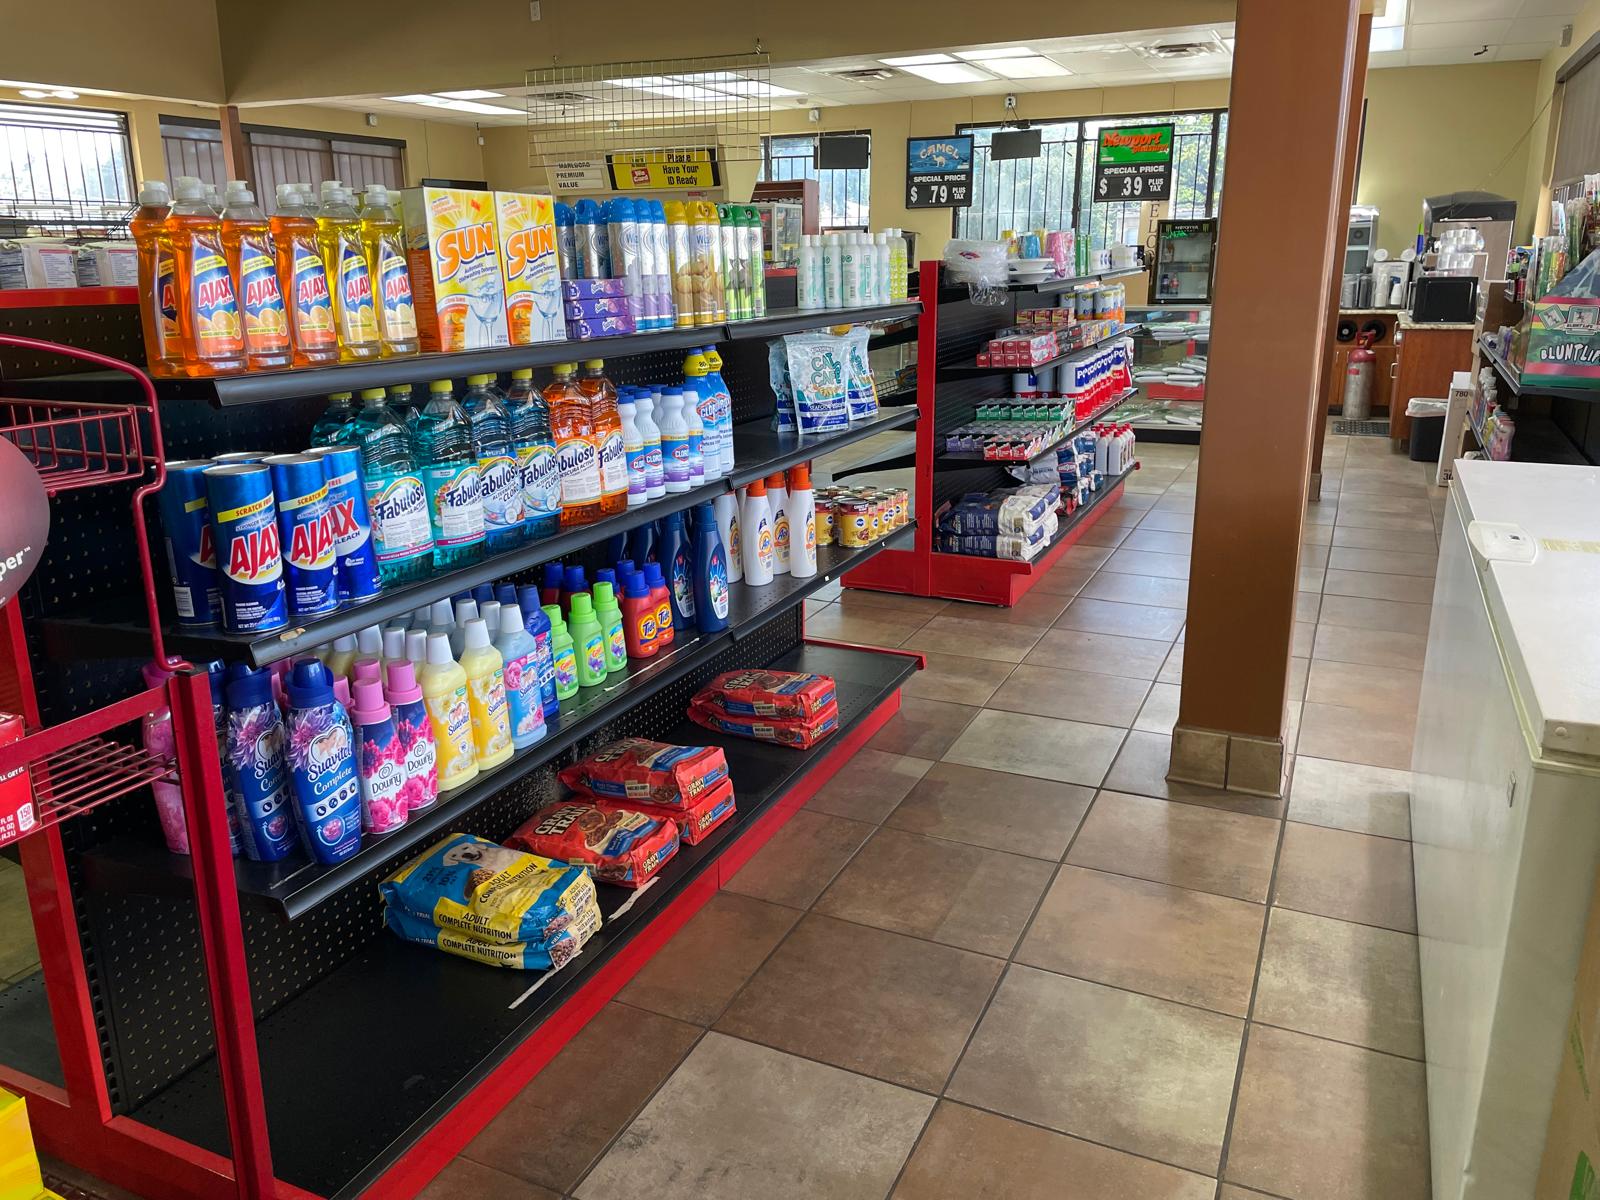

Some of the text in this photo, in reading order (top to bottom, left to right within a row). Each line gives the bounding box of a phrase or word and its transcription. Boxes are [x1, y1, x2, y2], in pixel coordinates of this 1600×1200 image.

[1102, 131, 1162, 147] Newport
[667, 154, 691, 162] Please
[920, 144, 959, 159] CAMEL
[662, 165, 699, 174] Have Your
[944, 174, 966, 182] PRICE
[1104, 165, 1164, 174] SPECIAL PRICE
[668, 176, 698, 186] ID Ready
[1099, 176, 1142, 196] $ .39
[1148, 178, 1164, 186] PLUS
[910, 185, 948, 203] $ .79
[436, 222, 498, 284] SUN
[506, 224, 556, 282] SUN
[198, 275, 231, 307] AJAX
[246, 275, 280, 307] AJAX
[298, 274, 327, 304] AJAX
[346, 274, 368, 304] AJAX
[386, 274, 410, 304] AJAX
[1455, 390, 1468, 398] 780
[297, 492, 321, 506] SCRATCH
[375, 484, 424, 523] Fabuloso
[235, 502, 263, 516] SCRATCH
[291, 510, 334, 566] AJA
[658, 610, 670, 624] Tide
[642, 622, 655, 636] Tide
[308, 742, 352, 782] Suavitel
[408, 752, 434, 772] Downy
[8, 770, 19, 778] GET
[314, 766, 353, 796] Complete
[372, 771, 402, 794] Downy
[688, 776, 704, 792] GRAVY
[689, 785, 705, 797] TRAIN
[20, 806, 31, 819] 150
[535, 804, 577, 835] GRAVY
[548, 806, 594, 836] TRAIN
[642, 852, 658, 868] GRAVY
[488, 870, 511, 886] ADULT
[506, 863, 538, 886] NUTRITION
[438, 914, 512, 940] COMPLETE NUTRITION
[463, 912, 490, 925] ADULT
[442, 938, 516, 960] COMPLETE NUTRITION
